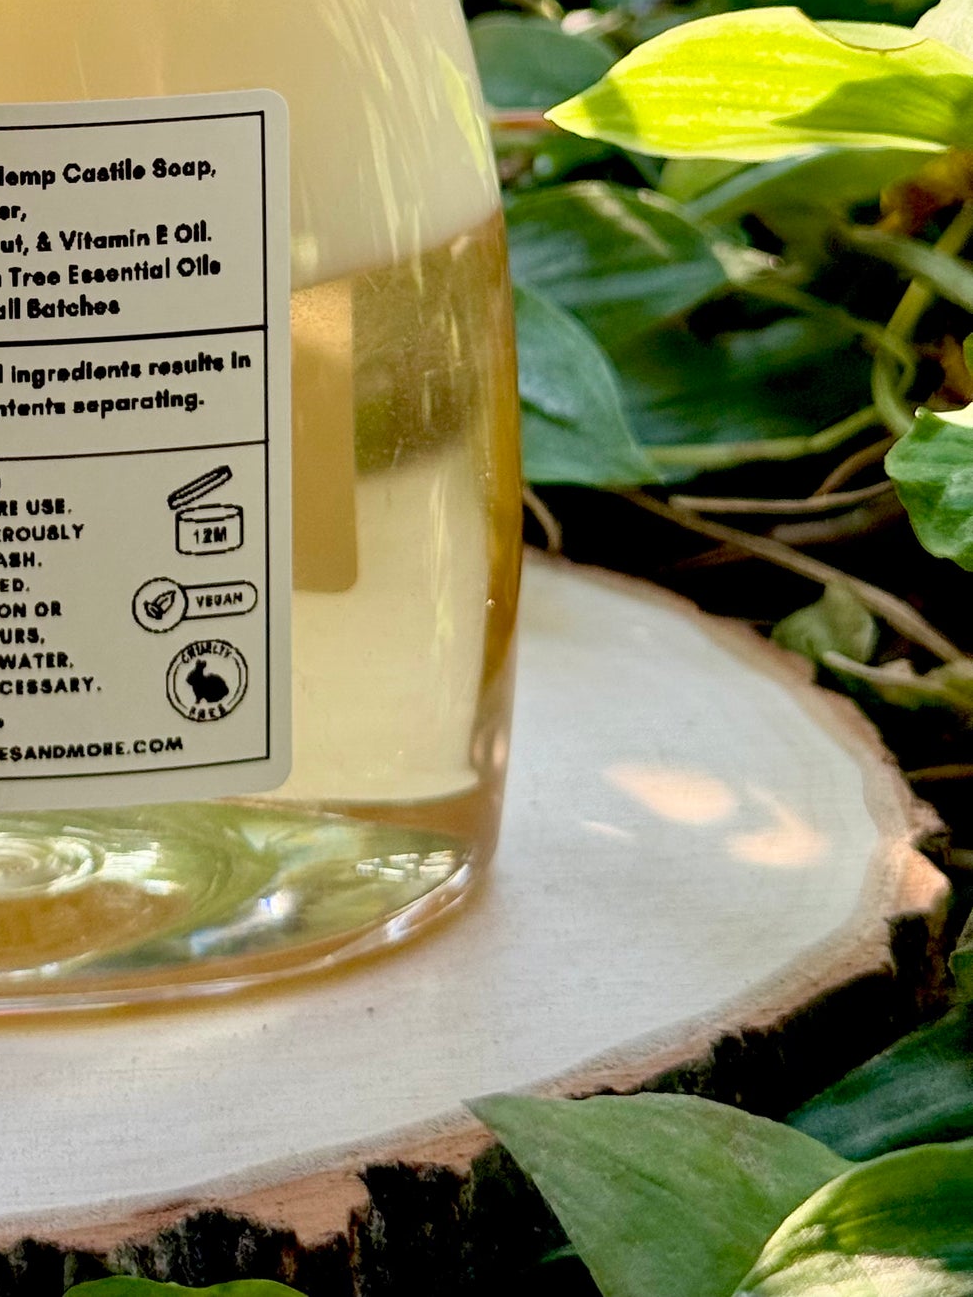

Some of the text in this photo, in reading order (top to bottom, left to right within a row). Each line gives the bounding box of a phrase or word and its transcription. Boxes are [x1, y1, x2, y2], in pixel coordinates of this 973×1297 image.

[61, 157, 147, 184] Castile
[35, 230, 53, 253] &
[58, 228, 151, 252] Vitamin
[155, 223, 169, 246] E
[7, 266, 61, 288] Tree
[68, 256, 171, 285] Essential
[26, 293, 121, 320] Batches
[10, 359, 143, 390] ingredients
[148, 351, 225, 377] results
[230, 350, 252, 370] in
[192, 527, 228, 544] 12M
[34, 600, 63, 618] OR
[195, 591, 244, 608] VEGAN
